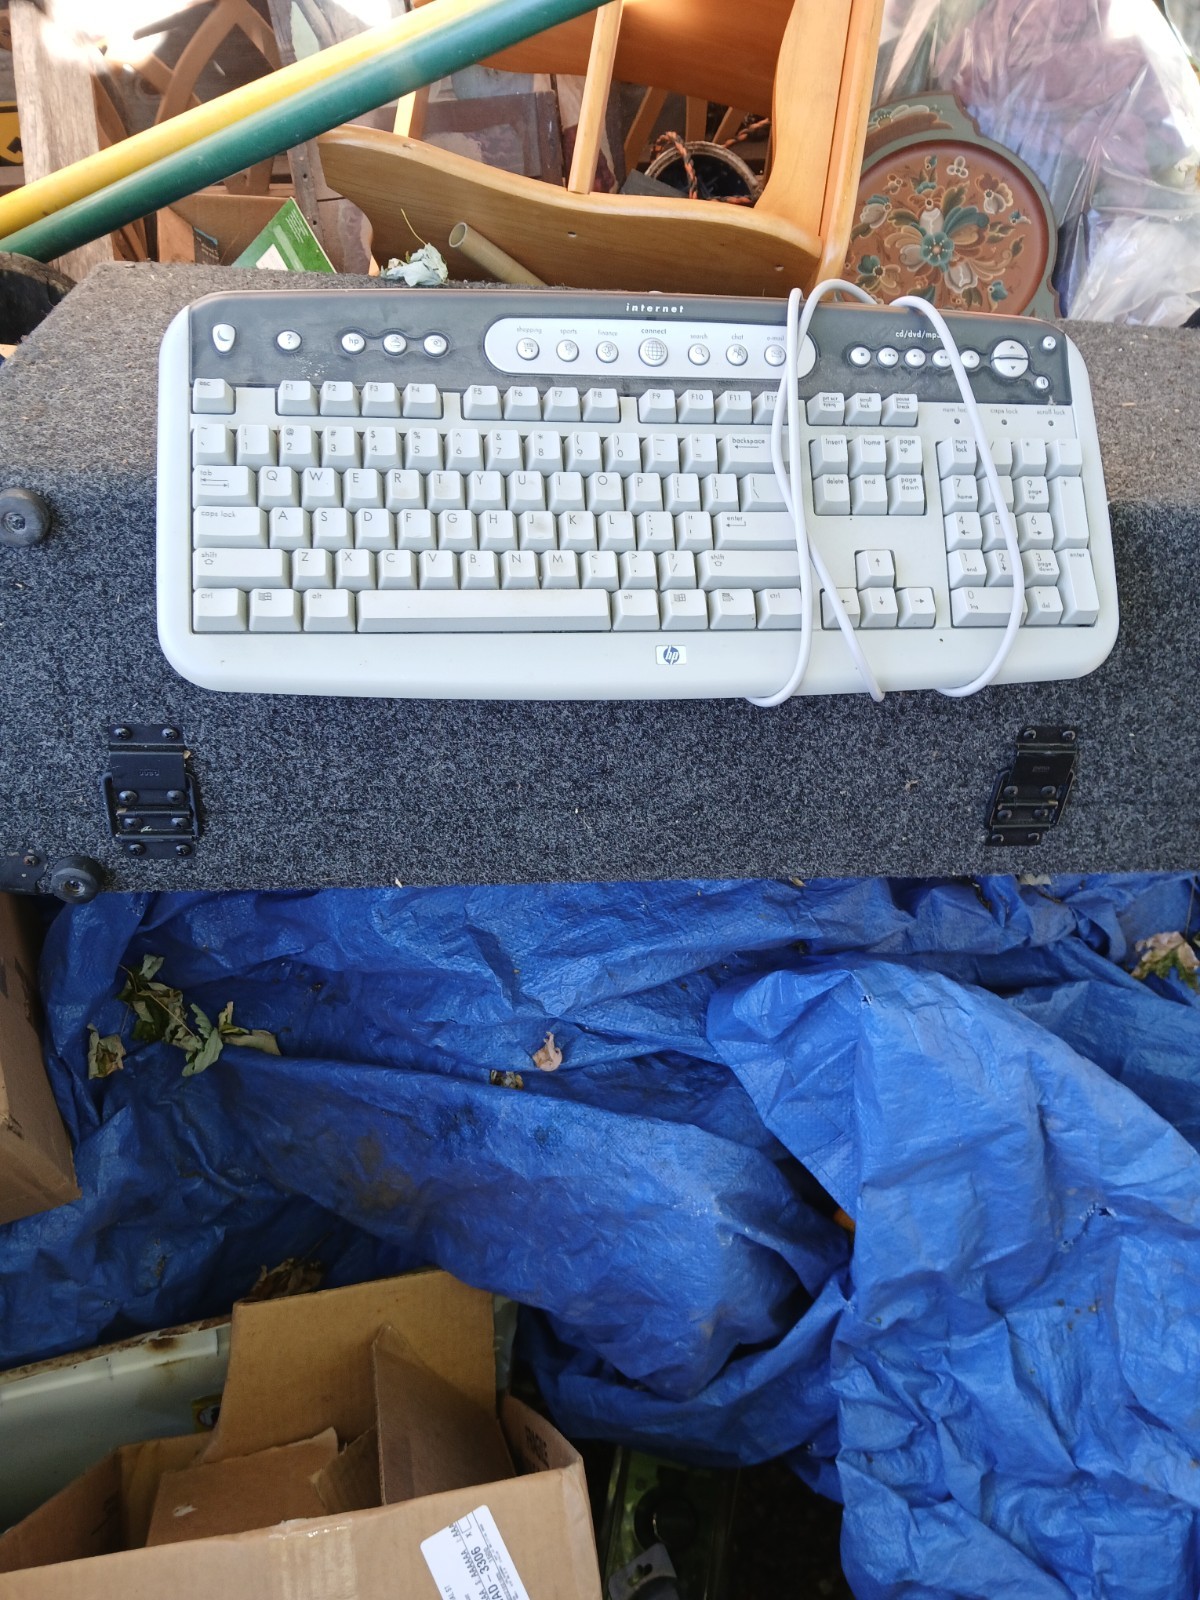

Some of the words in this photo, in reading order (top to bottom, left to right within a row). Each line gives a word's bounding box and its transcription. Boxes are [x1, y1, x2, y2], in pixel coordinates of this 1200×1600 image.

[626, 303, 684, 313] internet
[516, 326, 542, 334] shopping
[349, 337, 359, 346] hp
[266, 470, 278, 481] Q
[309, 471, 323, 481] W
[353, 473, 359, 483] E
[394, 473, 401, 483] R
[437, 474, 443, 483] T
[477, 475, 483, 485] Y
[518, 475, 526, 485] U
[598, 475, 608, 485] O
[638, 477, 643, 486] P
[956, 479, 961, 487] 7
[278, 511, 288, 520] A
[321, 512, 327, 521] S
[364, 512, 372, 521] D
[406, 513, 412, 522] F
[447, 513, 457, 523] G
[490, 514, 497, 523] H
[530, 515, 534, 524] J
[570, 515, 576, 524] K
[610, 515, 614, 524] L
[959, 516, 964, 524] 4
[995, 516, 1000, 524] 5
[1031, 516, 1036, 524] 6
[302, 552, 309, 561] Z
[345, 552, 352, 561] X
[386, 553, 395, 562] C
[428, 554, 437, 562] V
[470, 554, 476, 563] B
[512, 555, 521, 563] N
[999, 553, 1005, 562] 2
[1036, 553, 1041, 561] 3
[968, 590, 974, 599] 0
[664, 645, 679, 664] hp
[471, 1546, 489, 1574] 3306
